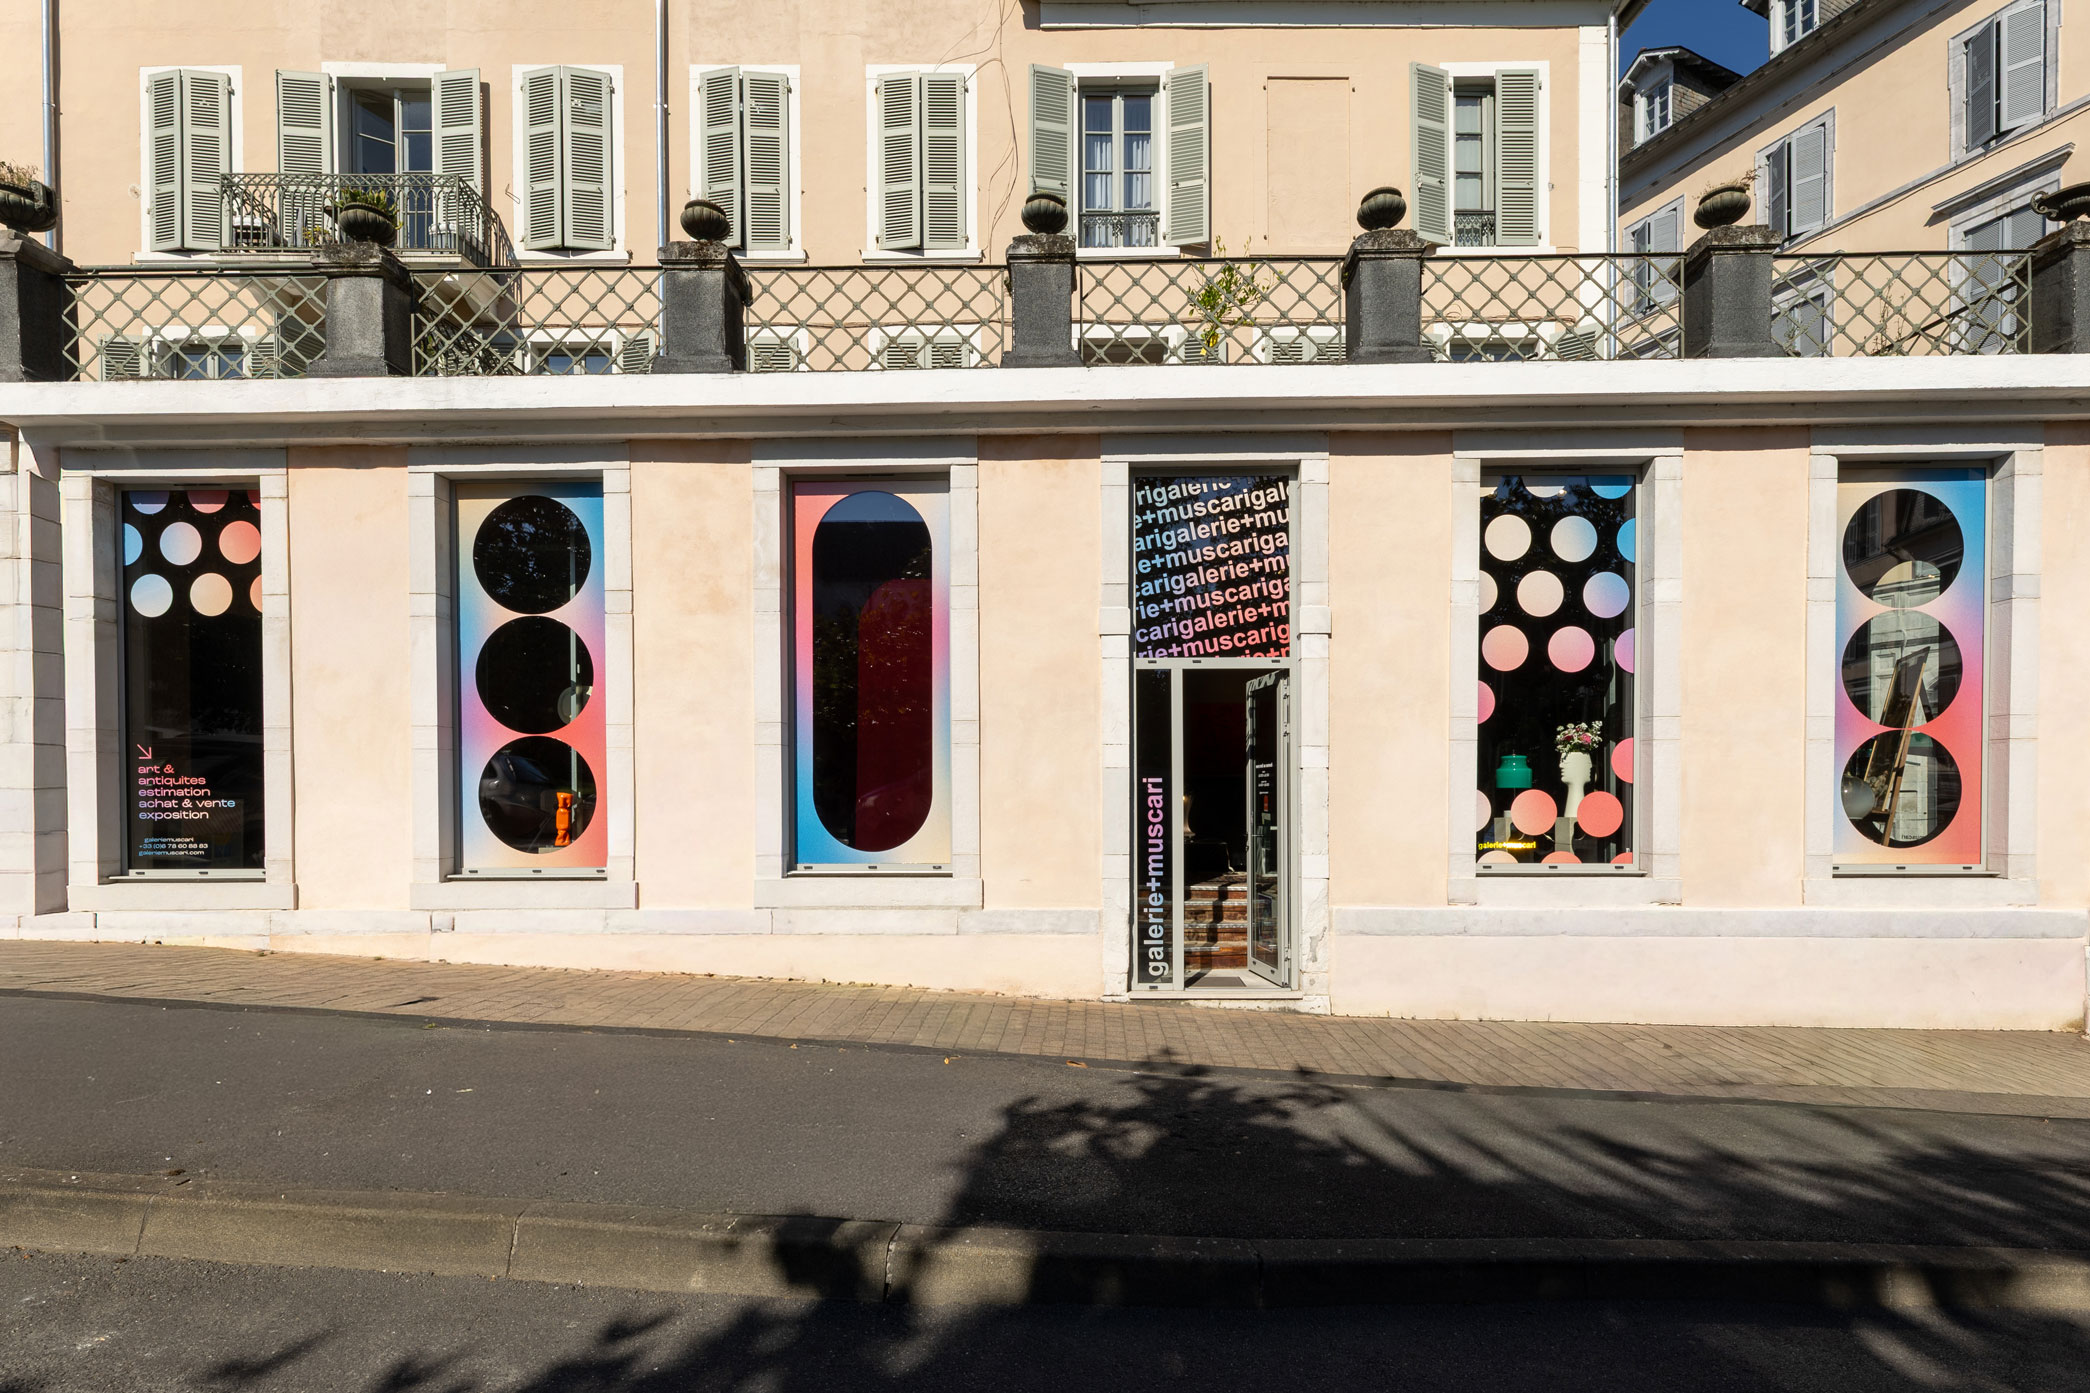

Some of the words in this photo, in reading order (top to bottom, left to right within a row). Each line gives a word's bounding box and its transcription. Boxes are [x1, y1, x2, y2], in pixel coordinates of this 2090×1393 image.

[1135, 481, 1289, 529] e+muscarigal
[138, 765, 160, 774] art
[163, 764, 175, 774] &
[138, 776, 206, 787] antiquites
[138, 787, 211, 797] estimation
[138, 799, 178, 808] achat
[181, 798, 193, 808] &
[195, 799, 236, 808] vente
[139, 810, 209, 821] exposition
[1143, 777, 1169, 977] galerie+muscari
